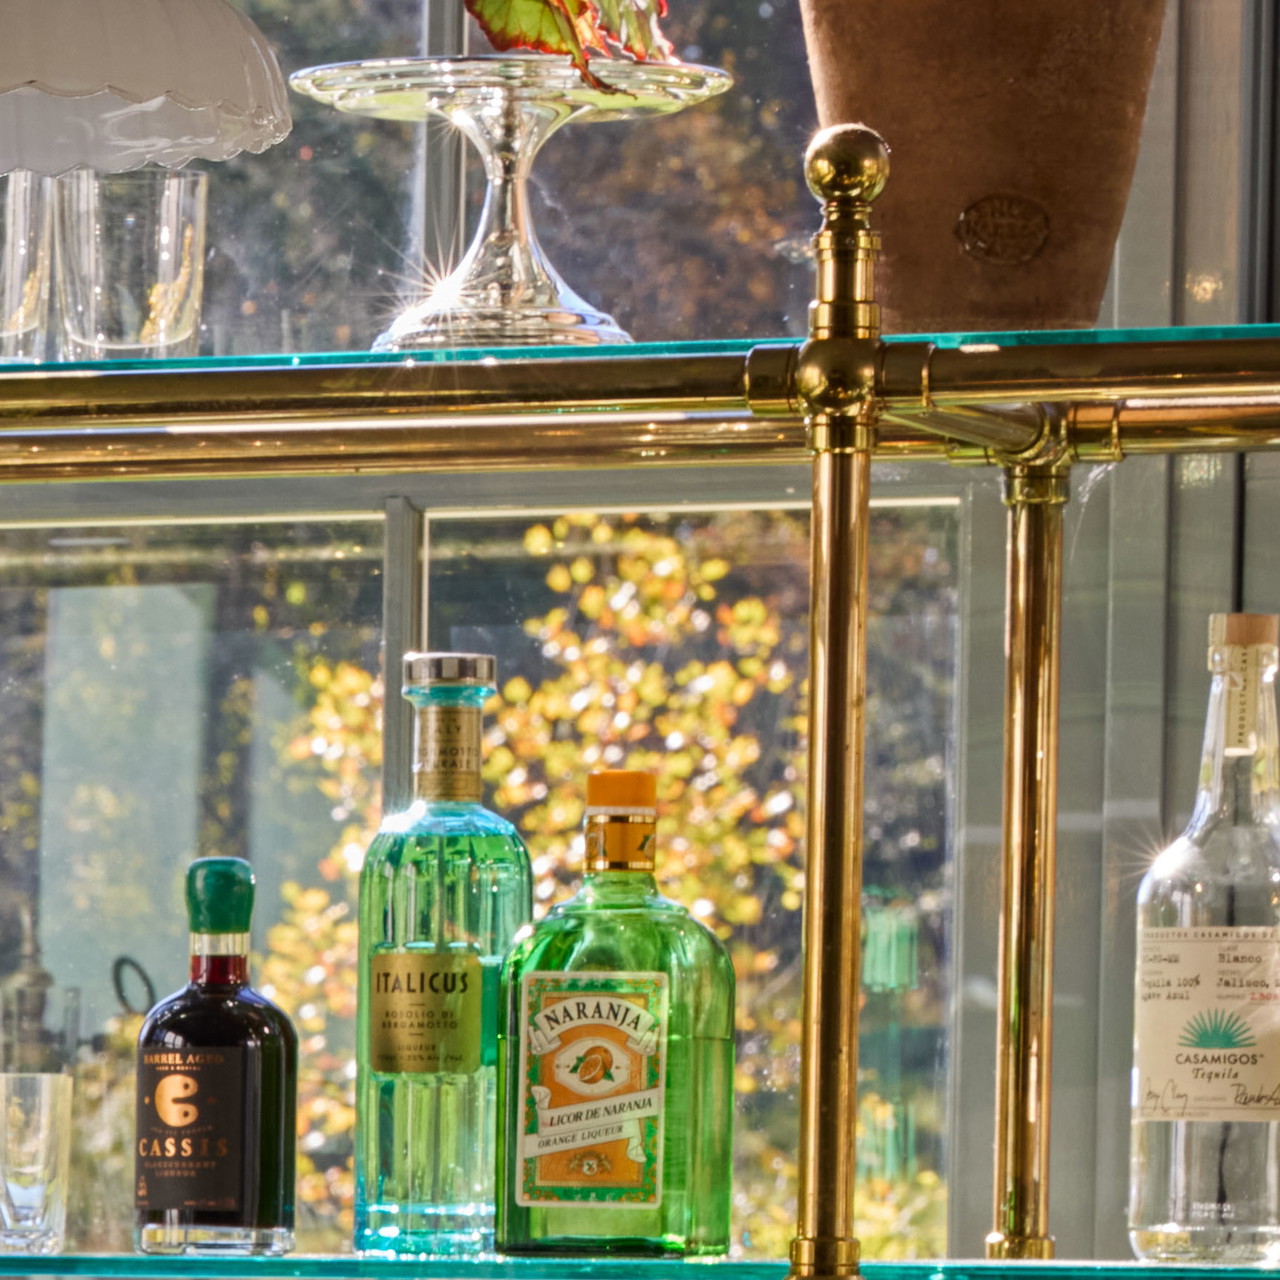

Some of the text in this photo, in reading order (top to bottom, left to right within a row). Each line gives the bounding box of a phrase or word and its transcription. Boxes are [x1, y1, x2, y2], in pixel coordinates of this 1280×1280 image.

[1217, 953, 1262, 963] Blanco
[376, 971, 468, 993] ITALICUS
[543, 1001, 641, 1031] NARANJA
[143, 1053, 183, 1064] BARREL
[1192, 1067, 1240, 1083] Tequila
[549, 1097, 653, 1128] LICOR DE NARANJA
[139, 1136, 228, 1158] CASSIS
[538, 1124, 624, 1149] ORANGE LIQUEUR
